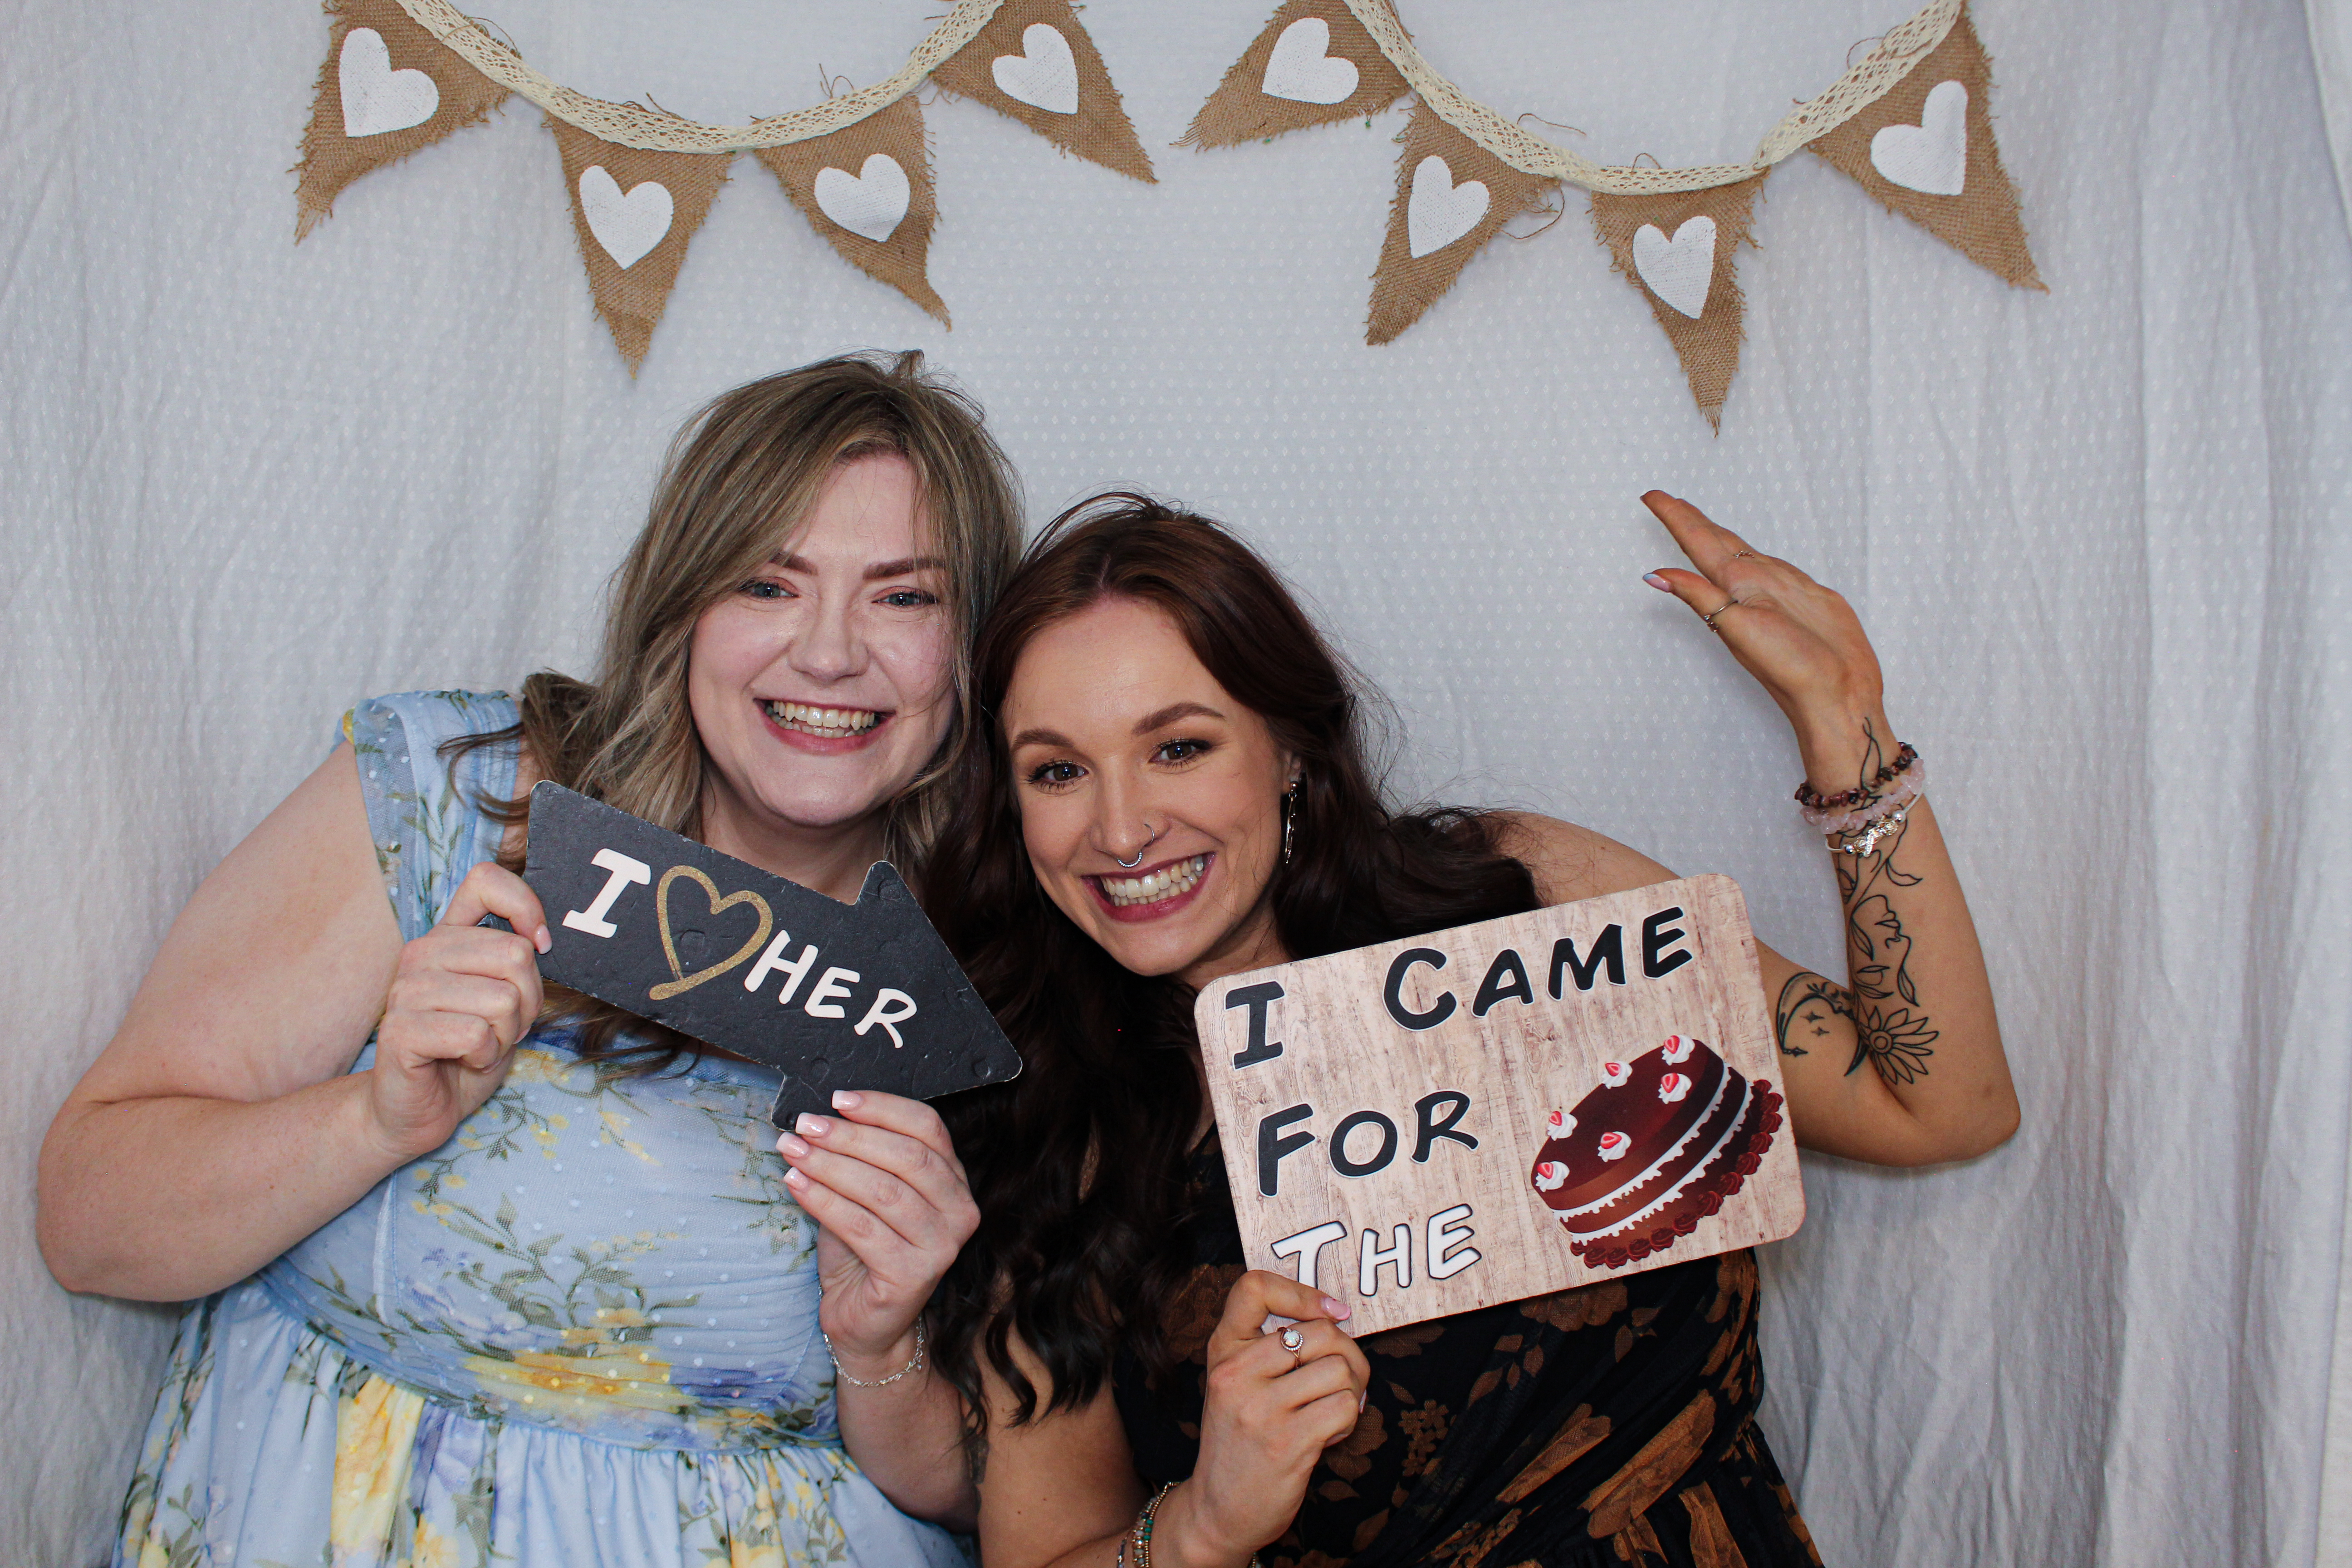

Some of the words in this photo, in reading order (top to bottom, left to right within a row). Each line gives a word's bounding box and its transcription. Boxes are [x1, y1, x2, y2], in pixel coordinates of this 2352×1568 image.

[562, 848, 651, 938] I
[744, 930, 917, 1049] HER
[1225, 981, 1285, 1069] I
[1383, 906, 1692, 1031] CAME
[1256, 1090, 1479, 1198] FOR
[1270, 1203, 1482, 1297] THE
